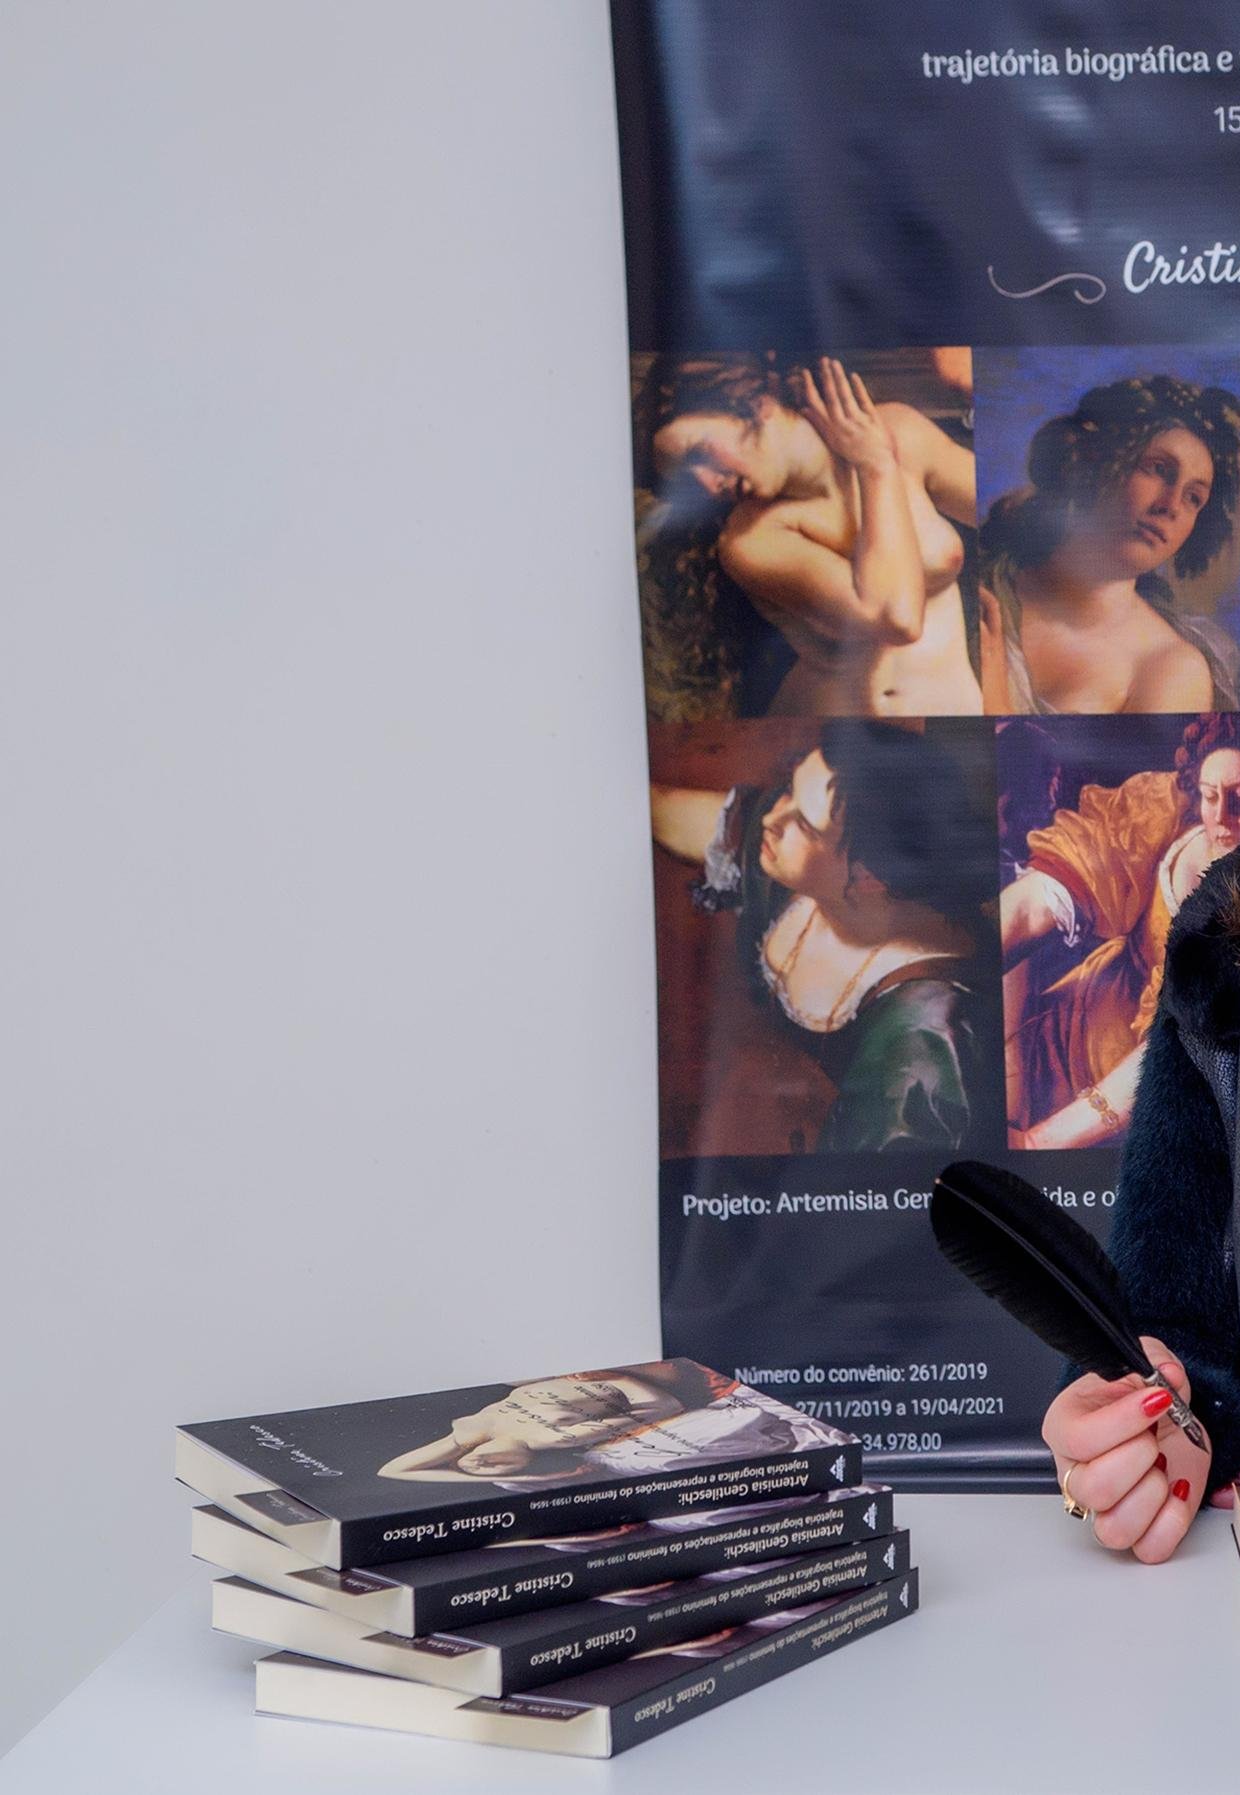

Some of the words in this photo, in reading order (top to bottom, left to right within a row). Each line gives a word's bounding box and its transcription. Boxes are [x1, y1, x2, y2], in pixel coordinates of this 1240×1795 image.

[921, 48, 1060, 84] trajetória
[1065, 45, 1211, 82] biográfica
[1216, 50, 1233, 73] e
[683, 1193, 772, 1221] Projeto:
[776, 1190, 889, 1214] Artemisia
[1083, 1190, 1096, 1207] e
[734, 1366, 800, 1385] Número
[803, 1365, 825, 1383] do
[828, 1364, 905, 1383] convênio:
[909, 1362, 988, 1382] 261/2019
[797, 1400, 892, 1418] 27/11/2019
[896, 1402, 906, 1416] a
[912, 1397, 1004, 1416] 19/04/2021
[718, 1466, 765, 1484] biográfica
[767, 1460, 809, 1477] trajetória
[574, 1488, 618, 1504] feminino
[620, 1486, 633, 1498] do
[635, 1475, 707, 1495] representações
[678, 1484, 749, 1507] Gentileschi:
[752, 1474, 809, 1498] Artemisia
[452, 1512, 516, 1532] Cristine
[805, 1509, 844, 1525] trajetória
[383, 1522, 448, 1542] Tedesco
[685, 1528, 751, 1549] representações
[791, 1522, 844, 1545] Artemisia
[627, 1545, 668, 1560] feminino
[670, 1542, 683, 1553] do
[724, 1534, 789, 1560] Gentileschi:
[514, 1572, 574, 1594] Cristine
[822, 1565, 868, 1587] Artemisia
[451, 1585, 512, 1607] Tedesco
[682, 1596, 718, 1612] feminino
[718, 1590, 730, 1602] do
[765, 1581, 821, 1606] Gentileschi:
[585, 1626, 637, 1650] Cristine
[530, 1642, 583, 1666] Tedesco
[676, 1677, 716, 1704] Cristine
[634, 1694, 675, 1722] Tedesco
